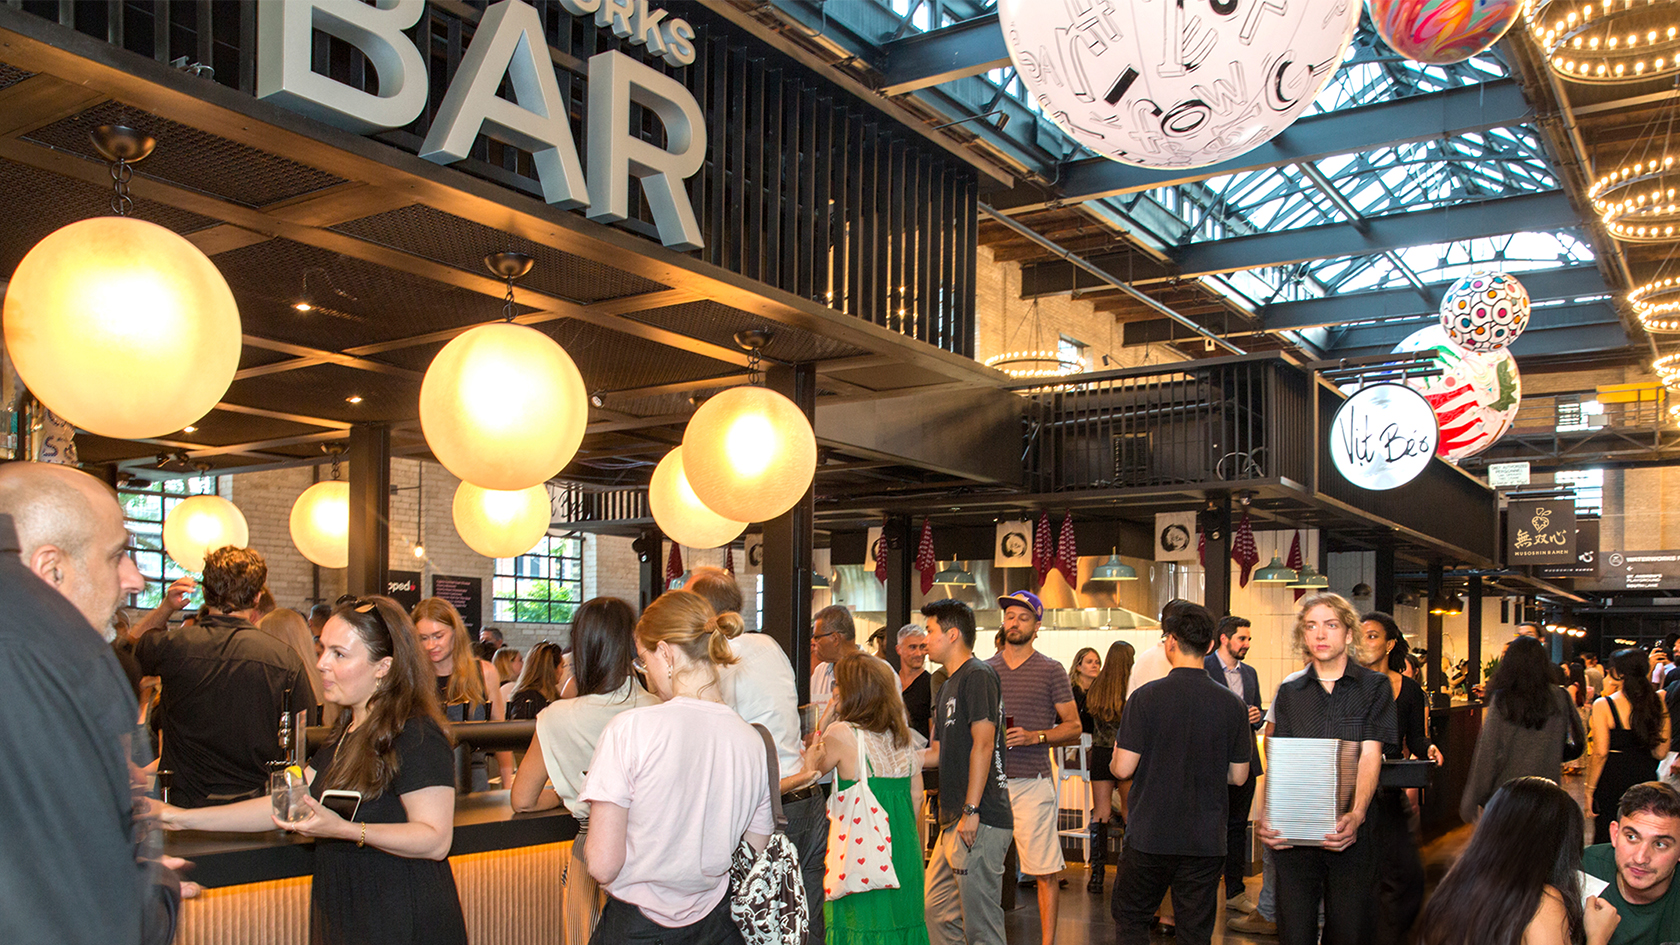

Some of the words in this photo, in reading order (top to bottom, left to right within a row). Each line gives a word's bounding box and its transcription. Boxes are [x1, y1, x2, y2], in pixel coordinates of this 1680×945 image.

[257, 0, 708, 251] BAR
[1514, 528, 1567, 549] 無双心
